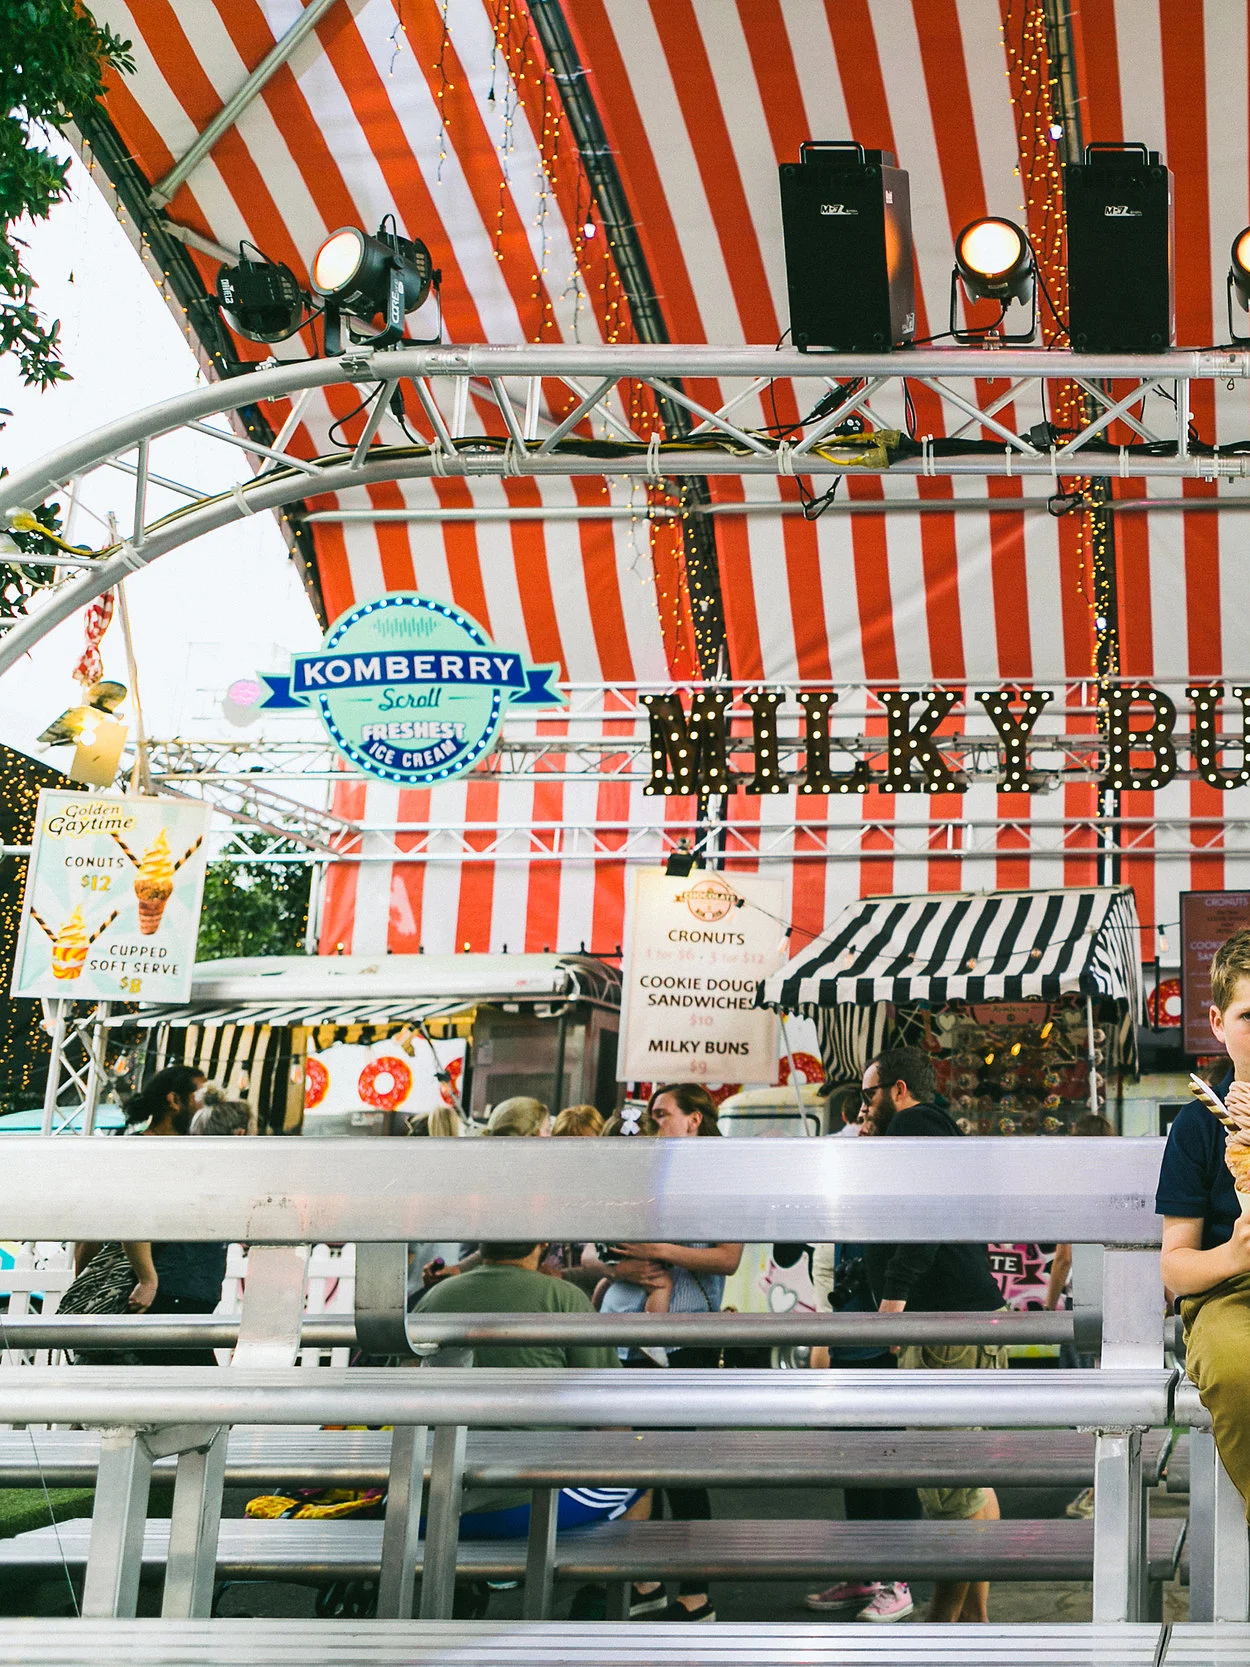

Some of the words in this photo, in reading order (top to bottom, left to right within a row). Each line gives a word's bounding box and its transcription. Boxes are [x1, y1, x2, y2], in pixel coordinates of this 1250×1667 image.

[303, 655, 514, 686] KOMBERRY
[378, 688, 442, 711] Scroll
[361, 721, 467, 741] FRESHEST
[640, 690, 1053, 796] MILKY
[369, 741, 395, 766] ICE
[401, 740, 458, 769] CREAM
[65, 805, 120, 818] Golden
[48, 817, 133, 836] Gaytime
[64, 856, 125, 869] CONUTS
[81, 875, 111, 892] $12
[668, 930, 745, 945] CRONUTS
[109, 945, 168, 958] CUPPED
[90, 960, 126, 972] SOFT
[134, 962, 180, 975] SERVE
[120, 976, 142, 994] $8
[640, 976, 701, 990] COOKIE
[689, 1014, 714, 1027] $10
[648, 1040, 700, 1054] MILKY
[705, 1042, 750, 1056] BUNS
[690, 1061, 708, 1075] $9
